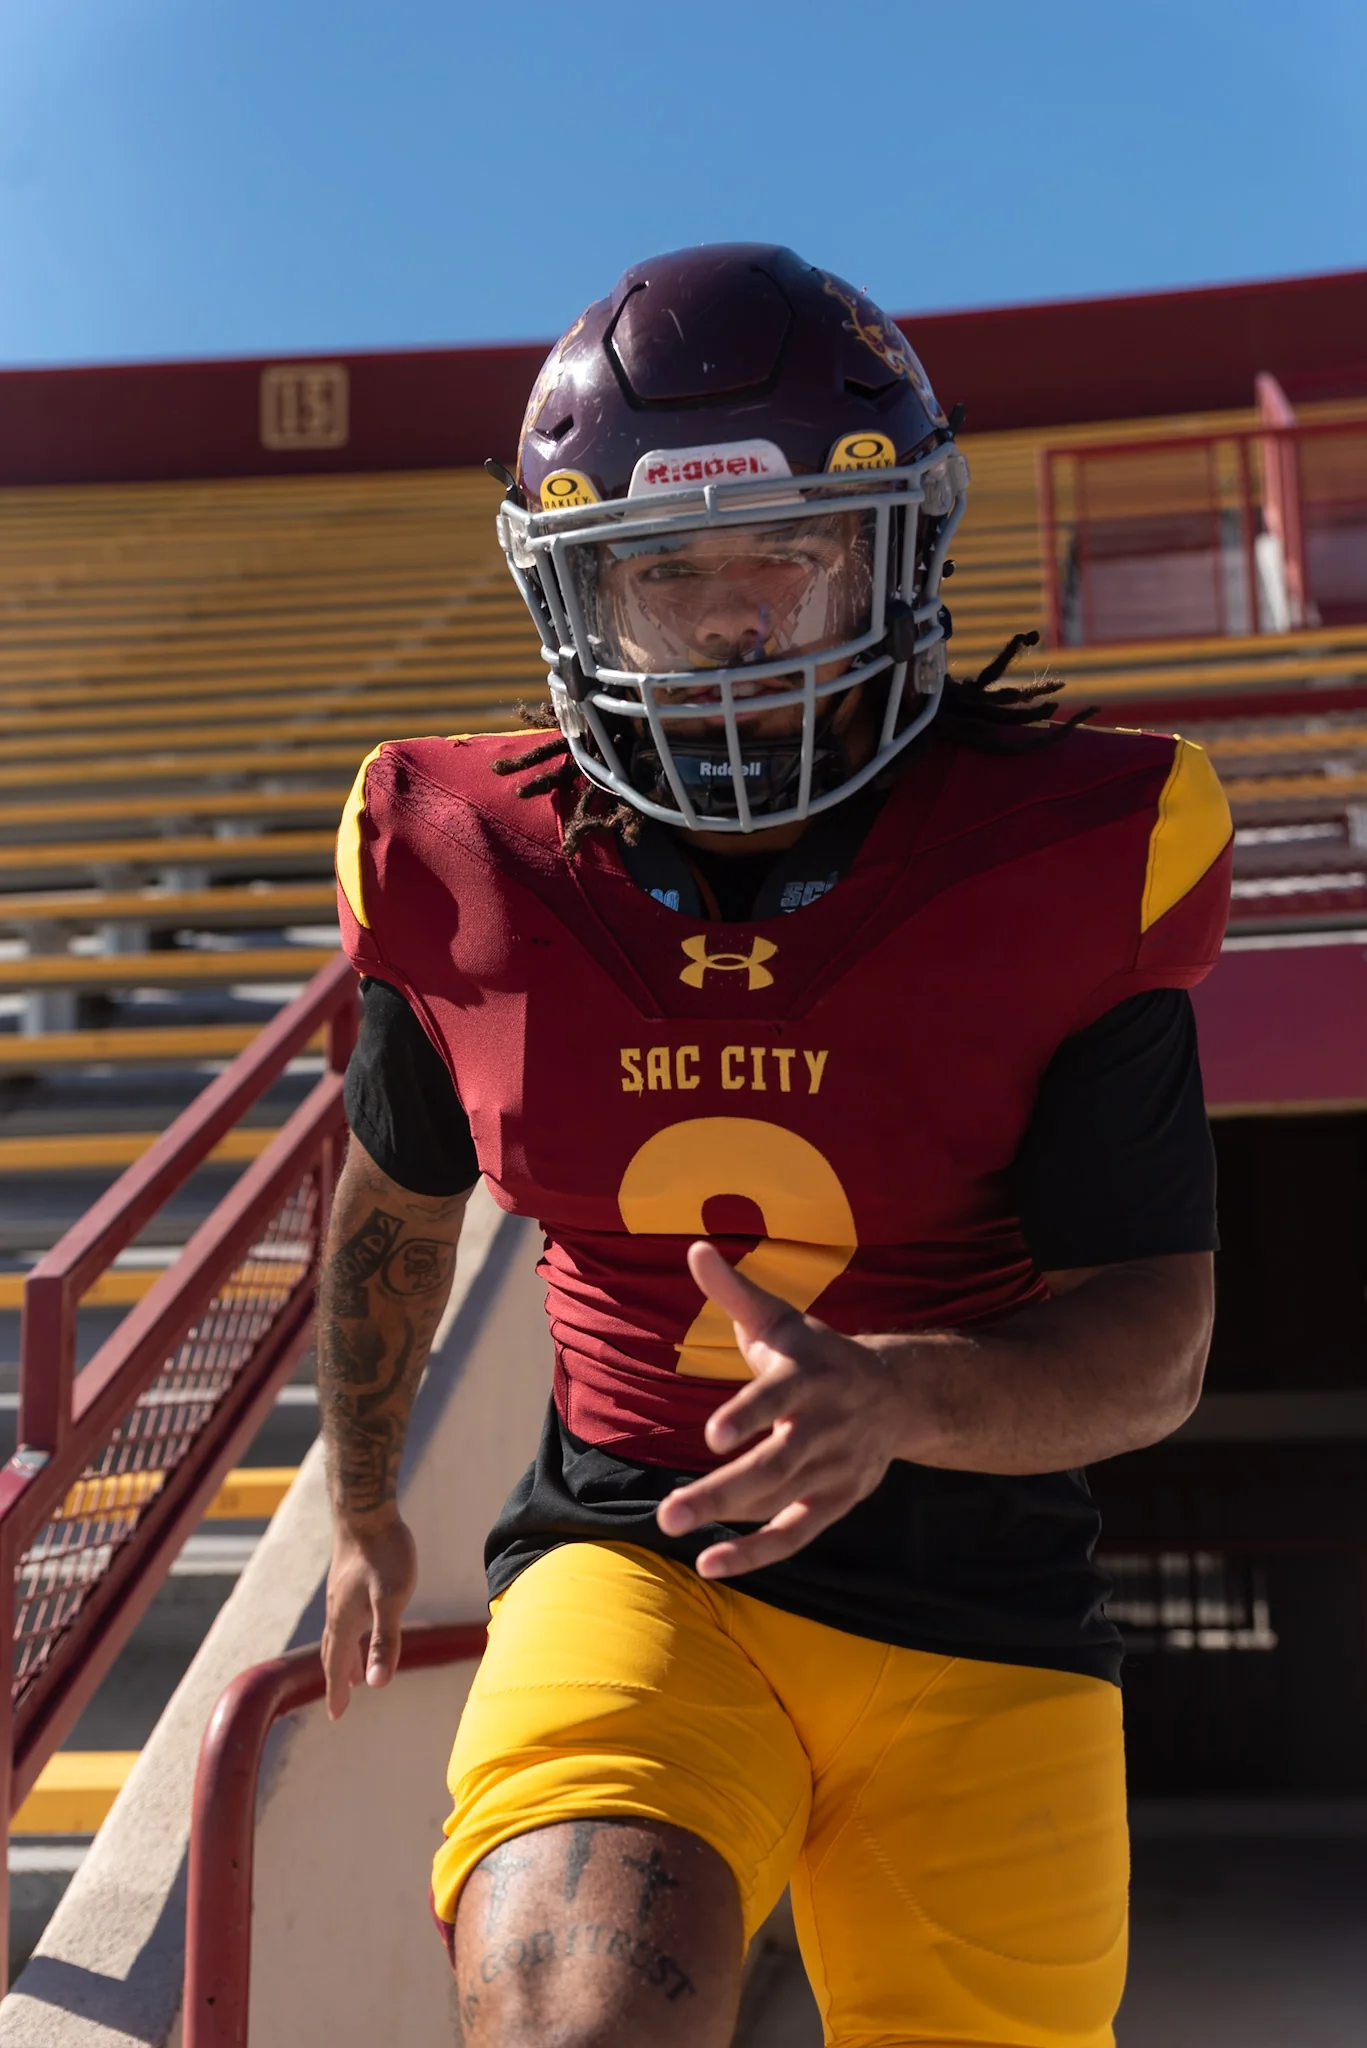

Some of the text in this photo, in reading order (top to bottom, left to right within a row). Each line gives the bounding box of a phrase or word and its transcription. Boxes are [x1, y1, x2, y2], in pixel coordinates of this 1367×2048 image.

[543, 496, 589, 509] OAKLEY
[620, 1045, 829, 1095] SAC CITY
[618, 1116, 858, 1381] 2
[481, 1928, 555, 1983] GOD
